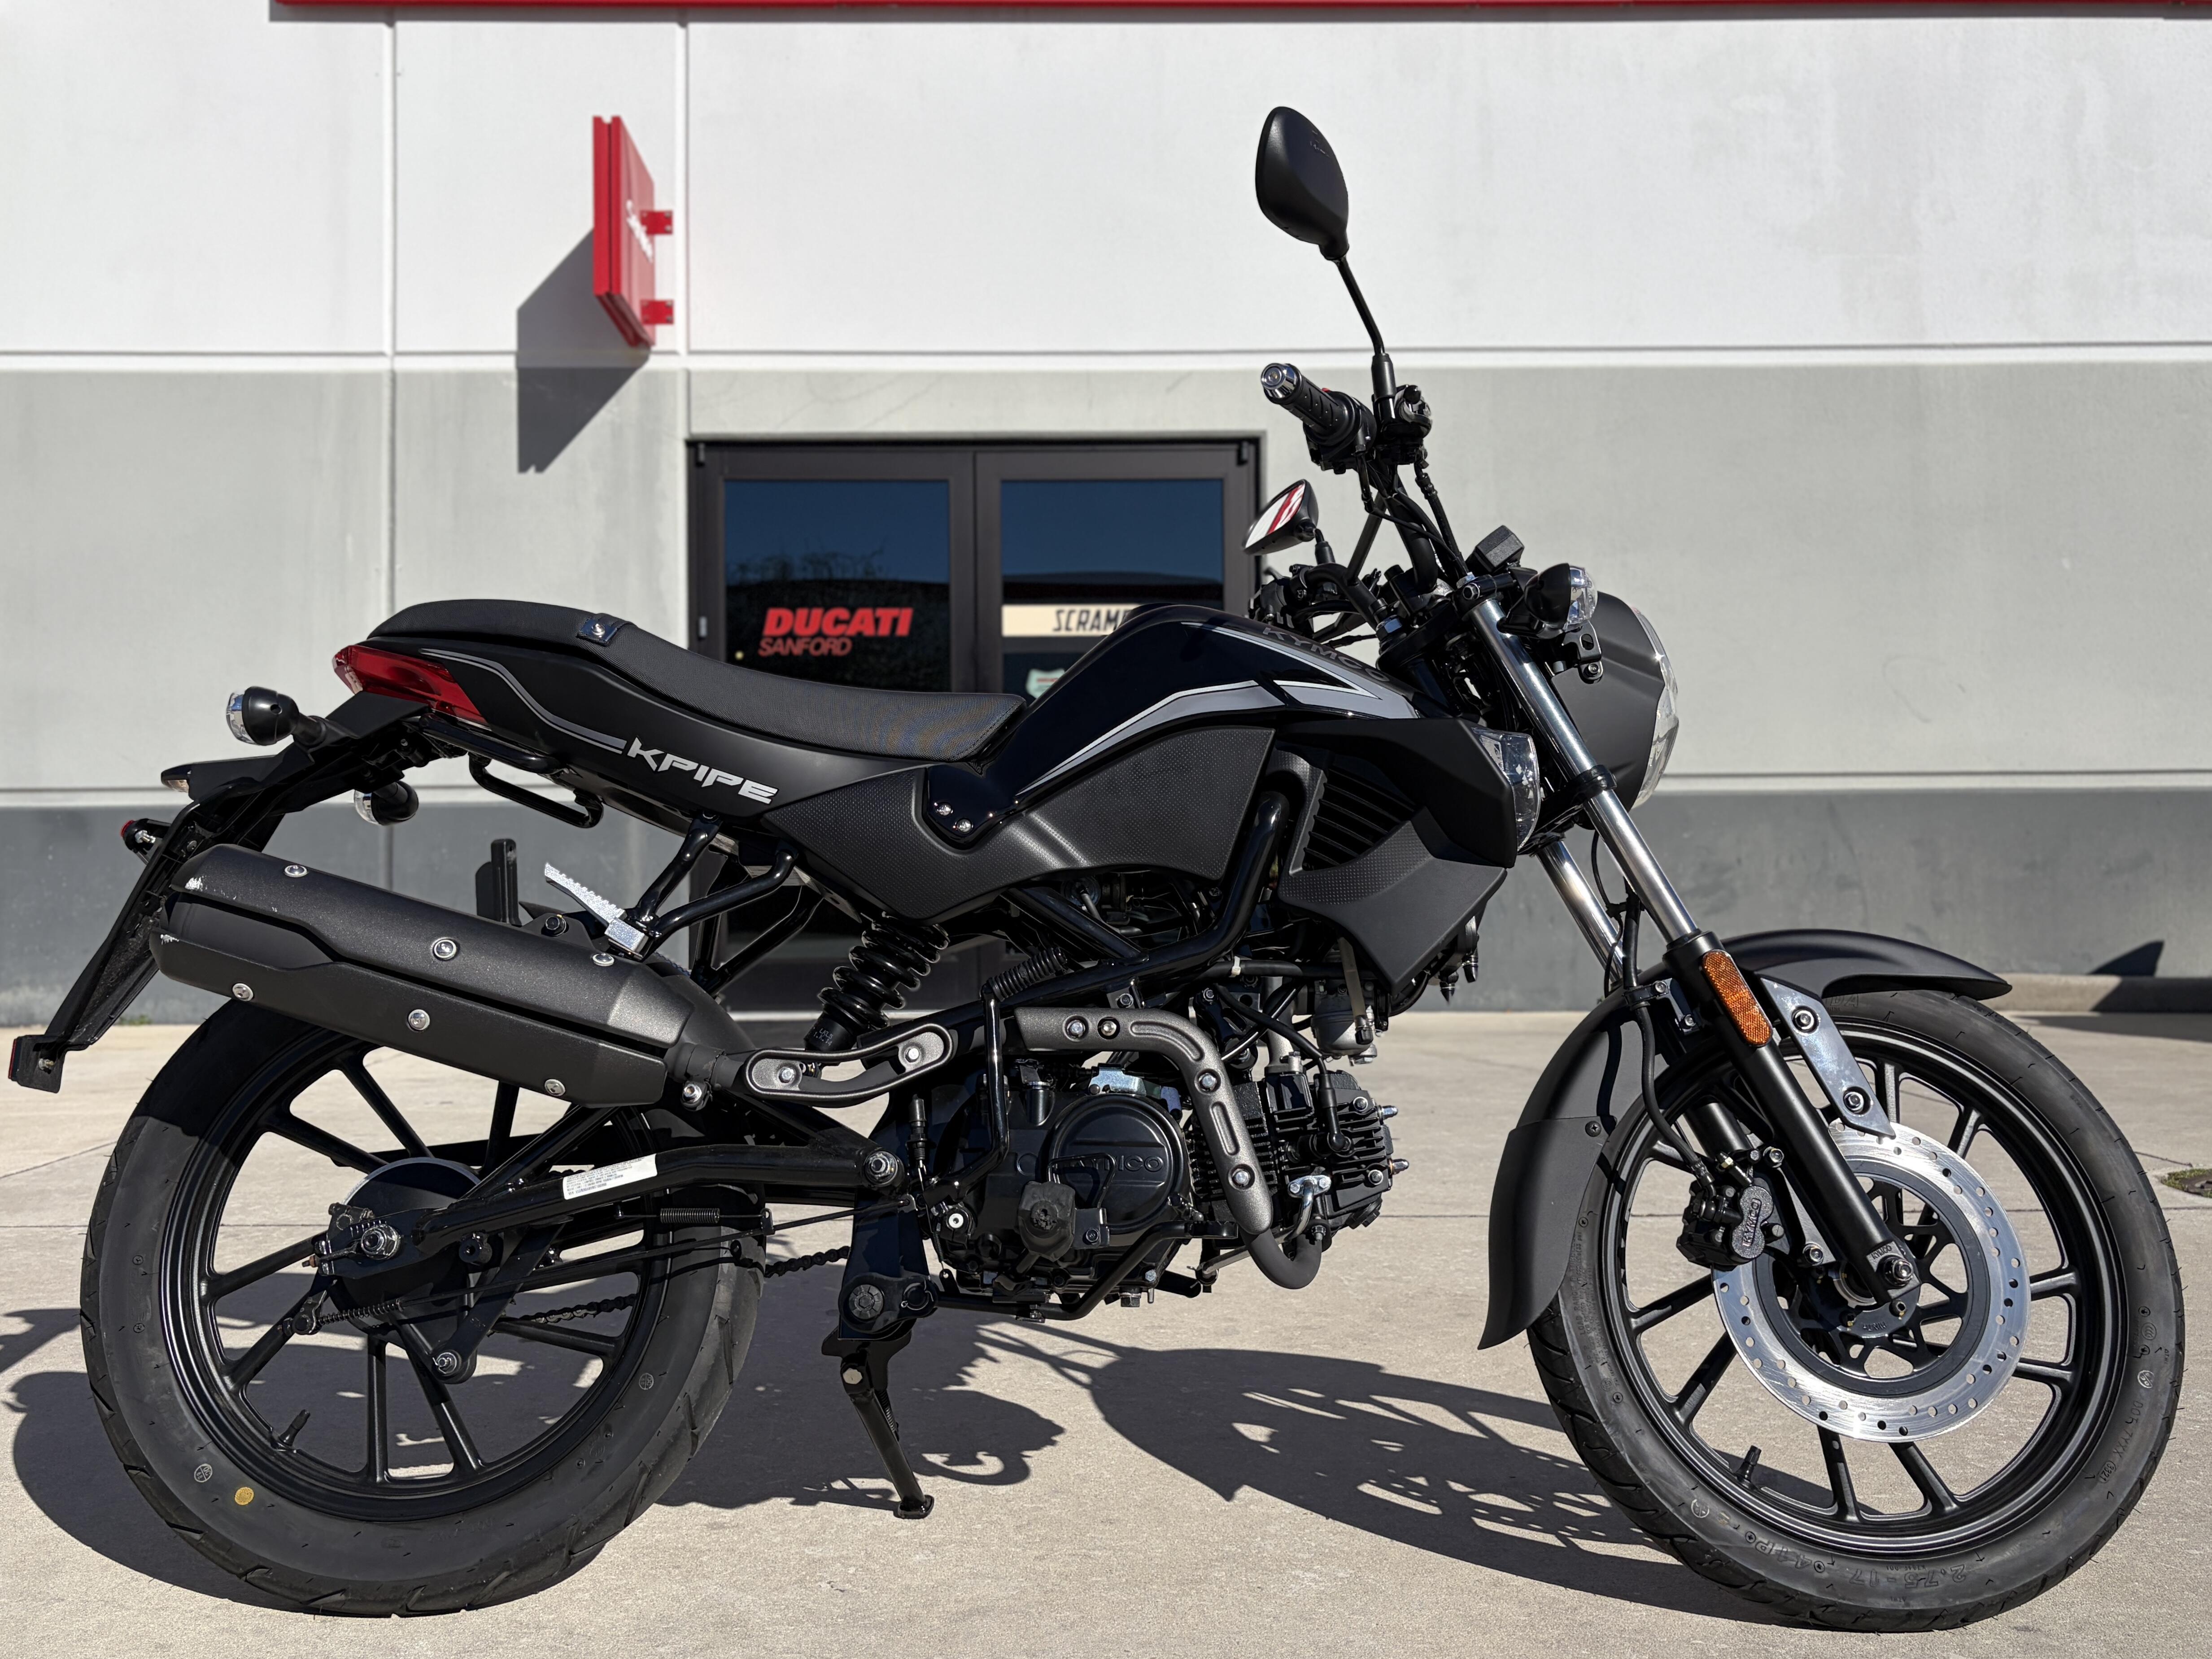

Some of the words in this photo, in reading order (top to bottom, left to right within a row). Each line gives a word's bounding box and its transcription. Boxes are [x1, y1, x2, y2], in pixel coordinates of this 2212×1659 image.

[763, 607, 914, 637] DUCATI
[758, 637, 852, 657] SANFORD
[1263, 627, 1390, 682] KYMCO
[627, 737, 778, 804] KPIPE
[1742, 1201, 1760, 1247] KYMCO
